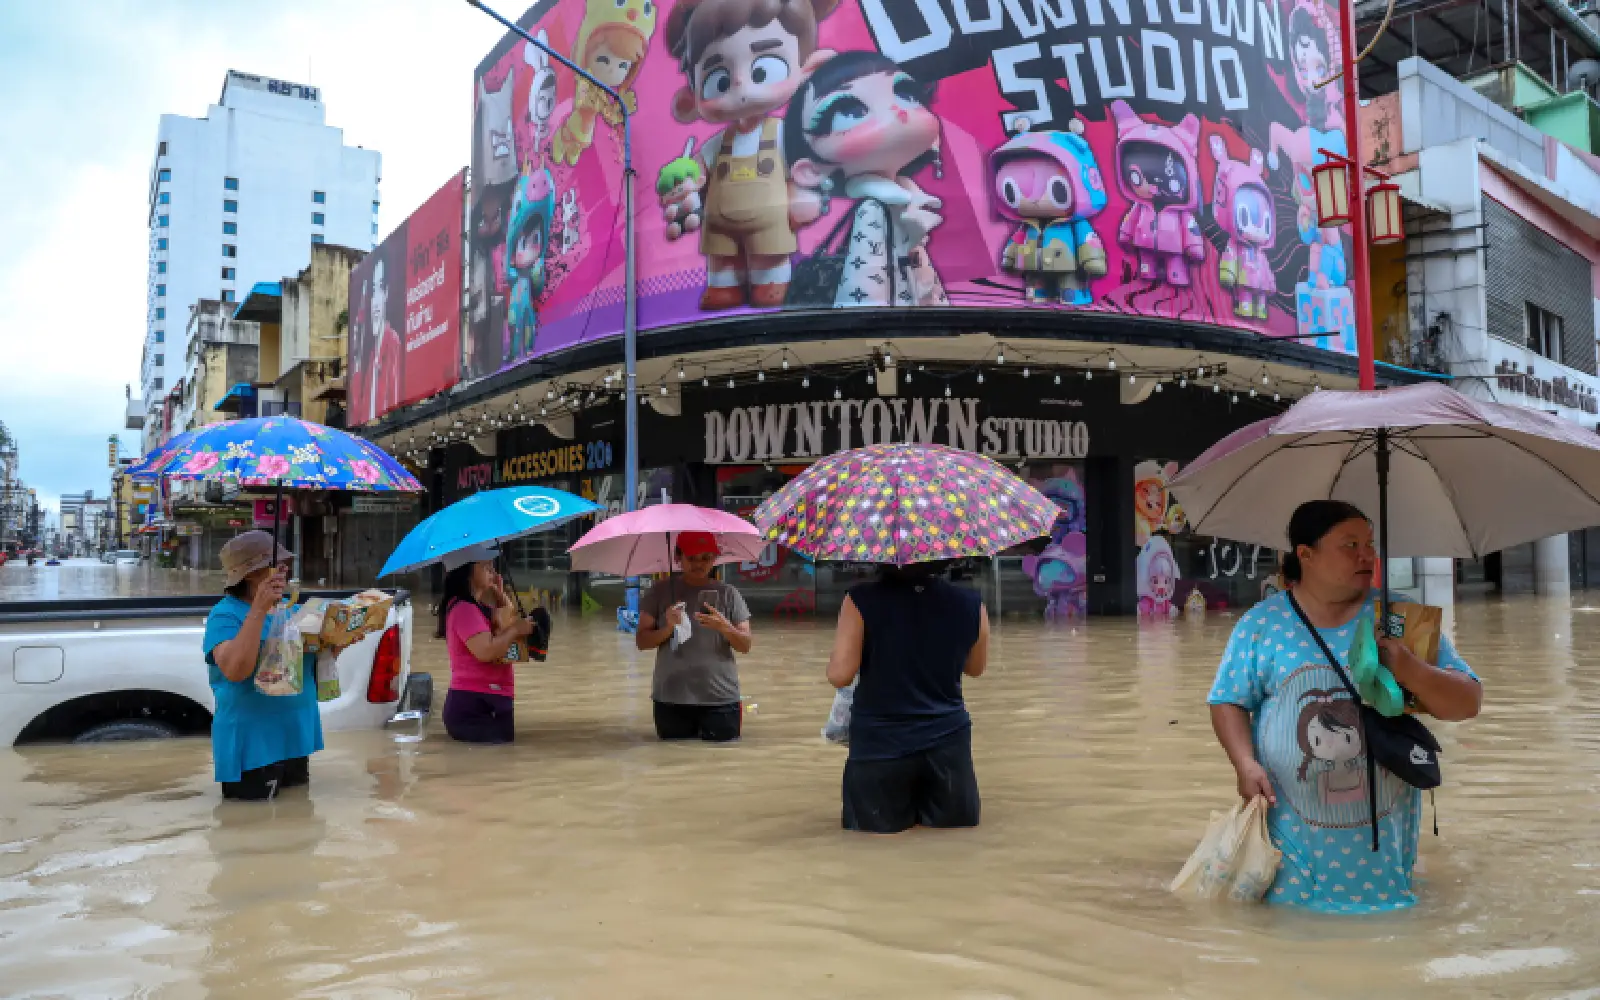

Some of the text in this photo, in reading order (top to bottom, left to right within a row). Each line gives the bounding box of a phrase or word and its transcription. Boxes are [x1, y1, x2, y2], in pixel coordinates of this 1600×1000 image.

[991, 29, 1249, 127] STUDIO
[502, 444, 584, 481] ACCESSORIES
[704, 397, 1089, 463] DOWNTOWN STUDIO
